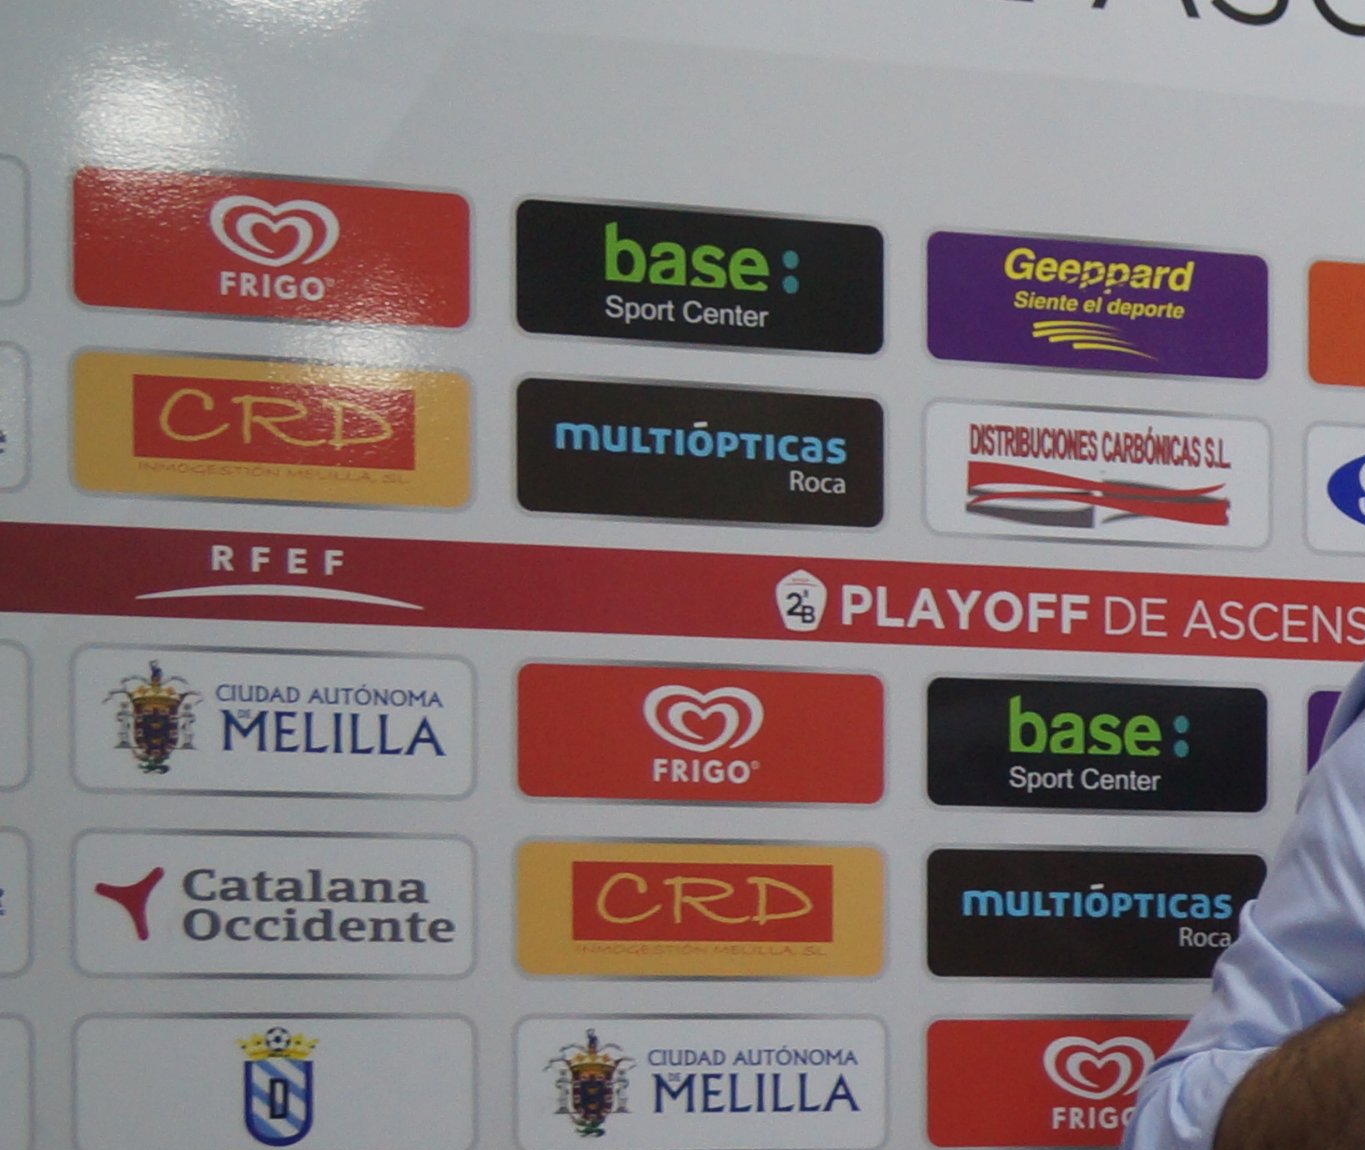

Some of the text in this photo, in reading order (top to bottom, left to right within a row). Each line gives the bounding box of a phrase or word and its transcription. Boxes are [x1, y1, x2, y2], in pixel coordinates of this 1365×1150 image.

[1004, 248, 1195, 294] Geeppard
[605, 294, 769, 327] Sport Center
[1014, 290, 1185, 320] Siente el deporte
[159, 388, 393, 450] CRD
[969, 423, 1098, 461] DISTRIBUCIONES
[1101, 426, 1200, 468] CARBÓNICAS
[789, 470, 846, 494] Roca
[212, 545, 345, 577] RFEF
[841, 584, 1089, 634] PLAYOFF
[1105, 598, 1167, 637] DE
[216, 684, 444, 708] CIUDAD AUTÓNOMA
[221, 709, 446, 756] MELILLA
[1009, 766, 1161, 793] Sport Center
[183, 867, 428, 905] Catalana
[596, 872, 814, 926] CRD
[183, 907, 456, 945] Occidente
[1179, 927, 1232, 948] Roca
[648, 1045, 859, 1066] CIUDAD AUTÓNOMA
[653, 1073, 861, 1114] MELILLA
